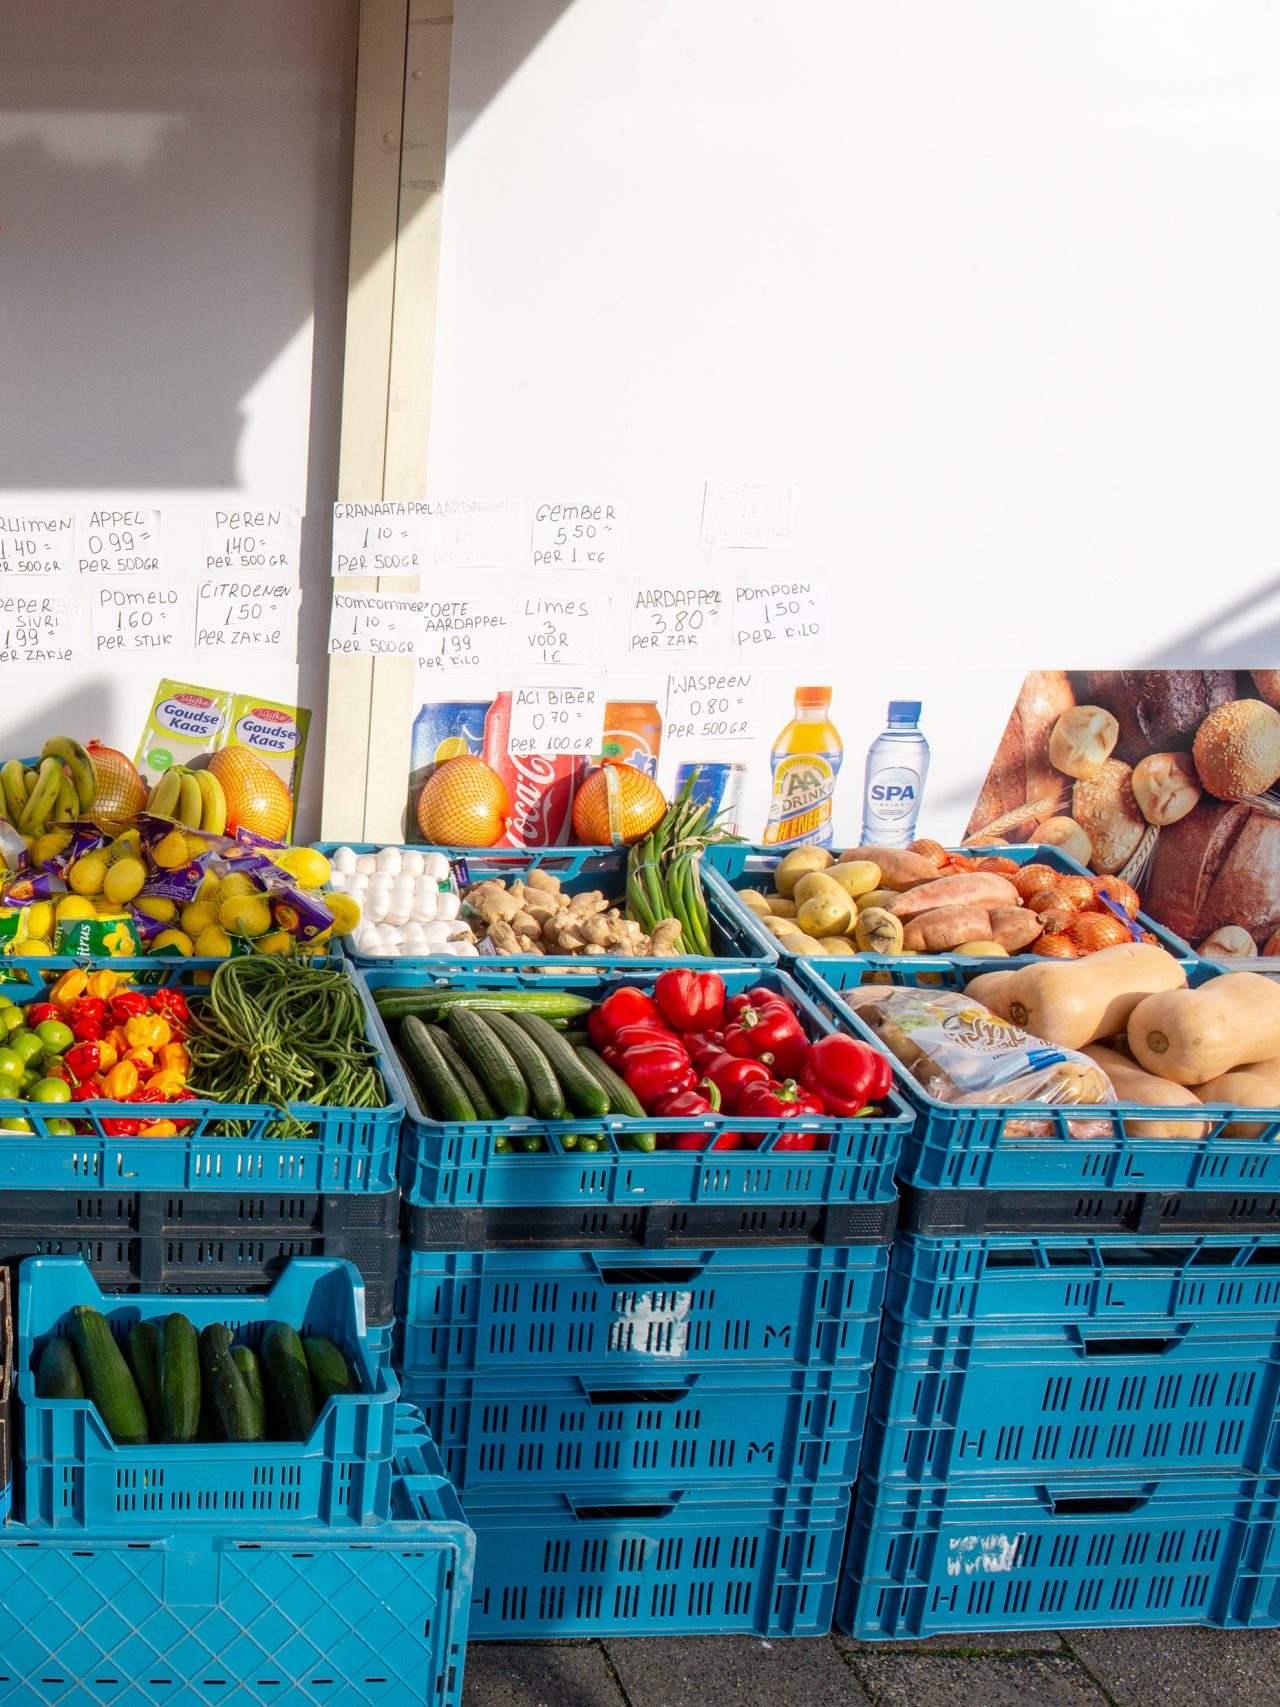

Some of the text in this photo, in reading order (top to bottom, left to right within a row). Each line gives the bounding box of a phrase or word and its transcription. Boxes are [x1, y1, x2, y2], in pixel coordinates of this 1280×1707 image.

[89, 511, 144, 528] APPEL
[89, 532, 134, 554] 0.99
[362, 527, 392, 548] 1.10
[554, 526, 596, 545] 5.50
[0, 540, 37, 559] 1.40
[116, 611, 153, 630] 1.60
[225, 604, 262, 625] 1.50
[765, 601, 800, 623] 1.50
[352, 616, 380, 635] 1.10
[543, 620, 557, 635] 3
[651, 610, 703, 634] 3.80
[5, 629, 38, 649] 1.99
[134, 634, 173, 646] STUK
[441, 635, 471, 655] 1.99
[528, 632, 569, 647] VOOR
[667, 635, 698, 645] ZAK
[164, 704, 220, 725] Goudse
[690, 698, 729, 716] 0.80
[169, 717, 209, 734] Kaas
[242, 720, 297, 740] Goudse
[532, 711, 568, 730] 0.70
[248, 733, 286, 749] Kaas
[787, 769, 822, 797] AA
[782, 786, 827, 812] DRINK
[871, 785, 915, 801] SPA
[76, 924, 91, 957] itrus
